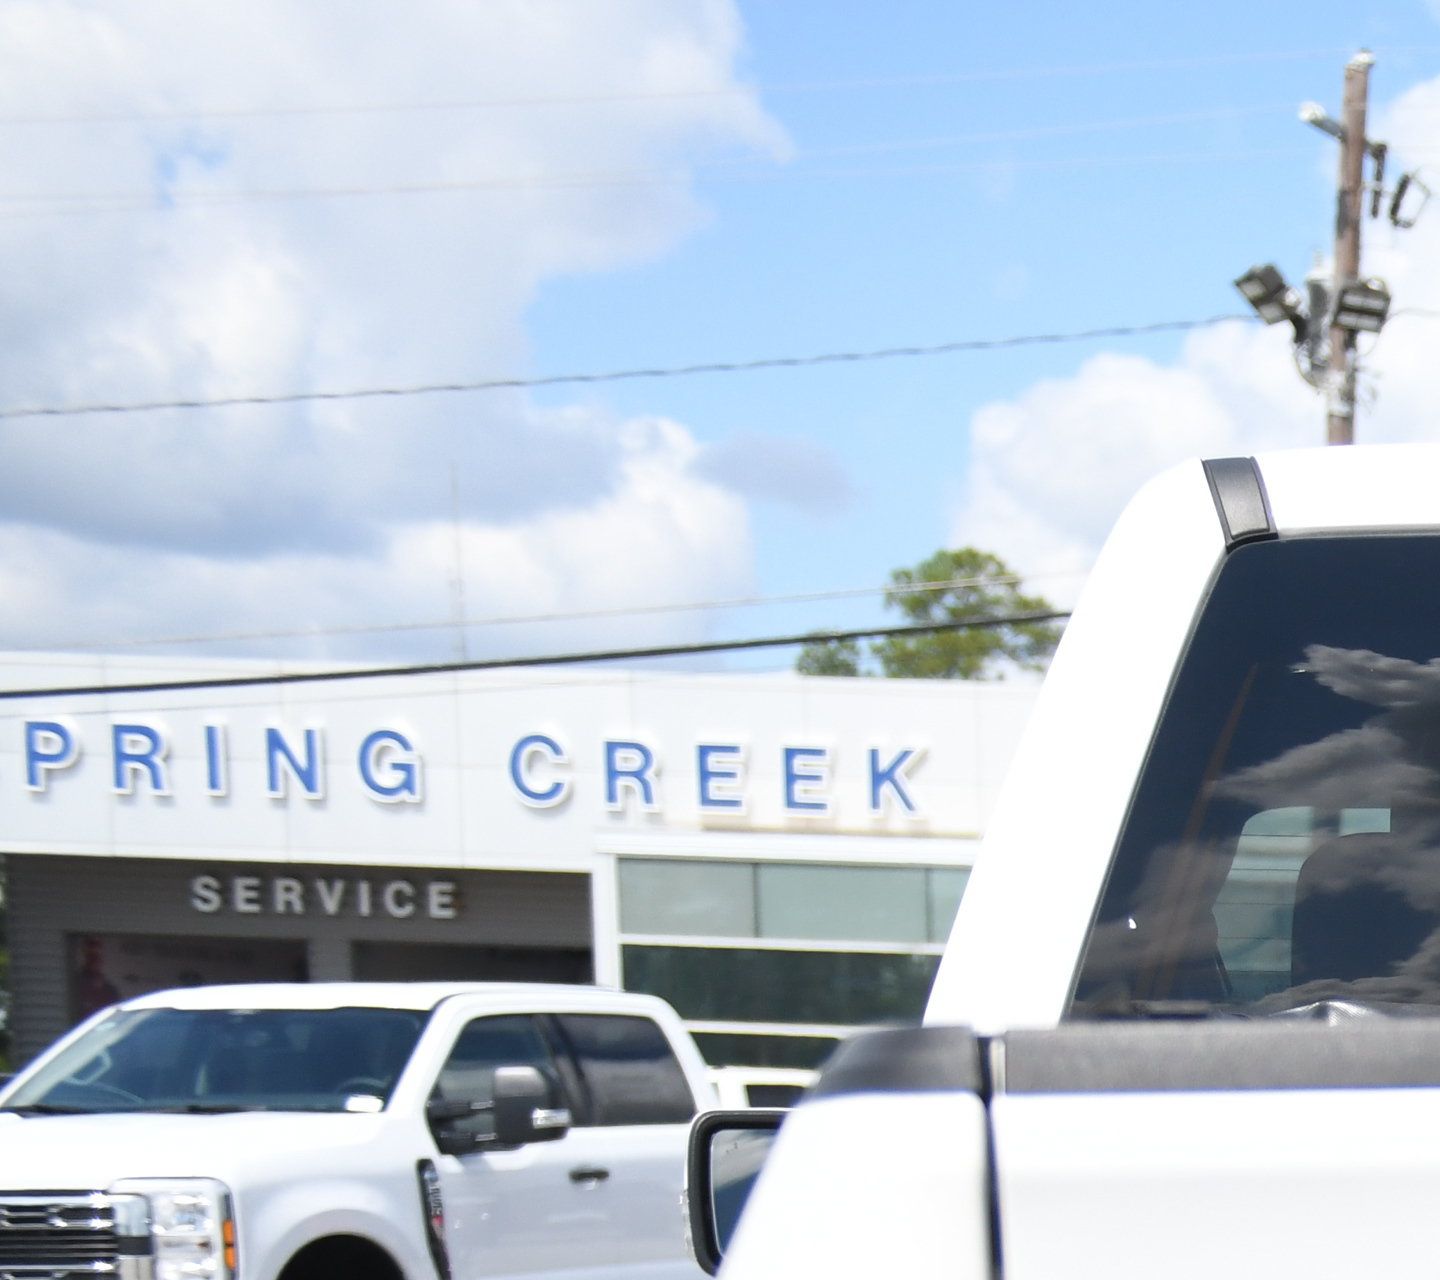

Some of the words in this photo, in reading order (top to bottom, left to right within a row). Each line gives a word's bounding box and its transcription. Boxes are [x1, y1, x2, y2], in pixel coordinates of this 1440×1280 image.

[22, 718, 422, 804] PRING
[509, 733, 922, 813] CREEK
[191, 875, 458, 919] SERVICE
